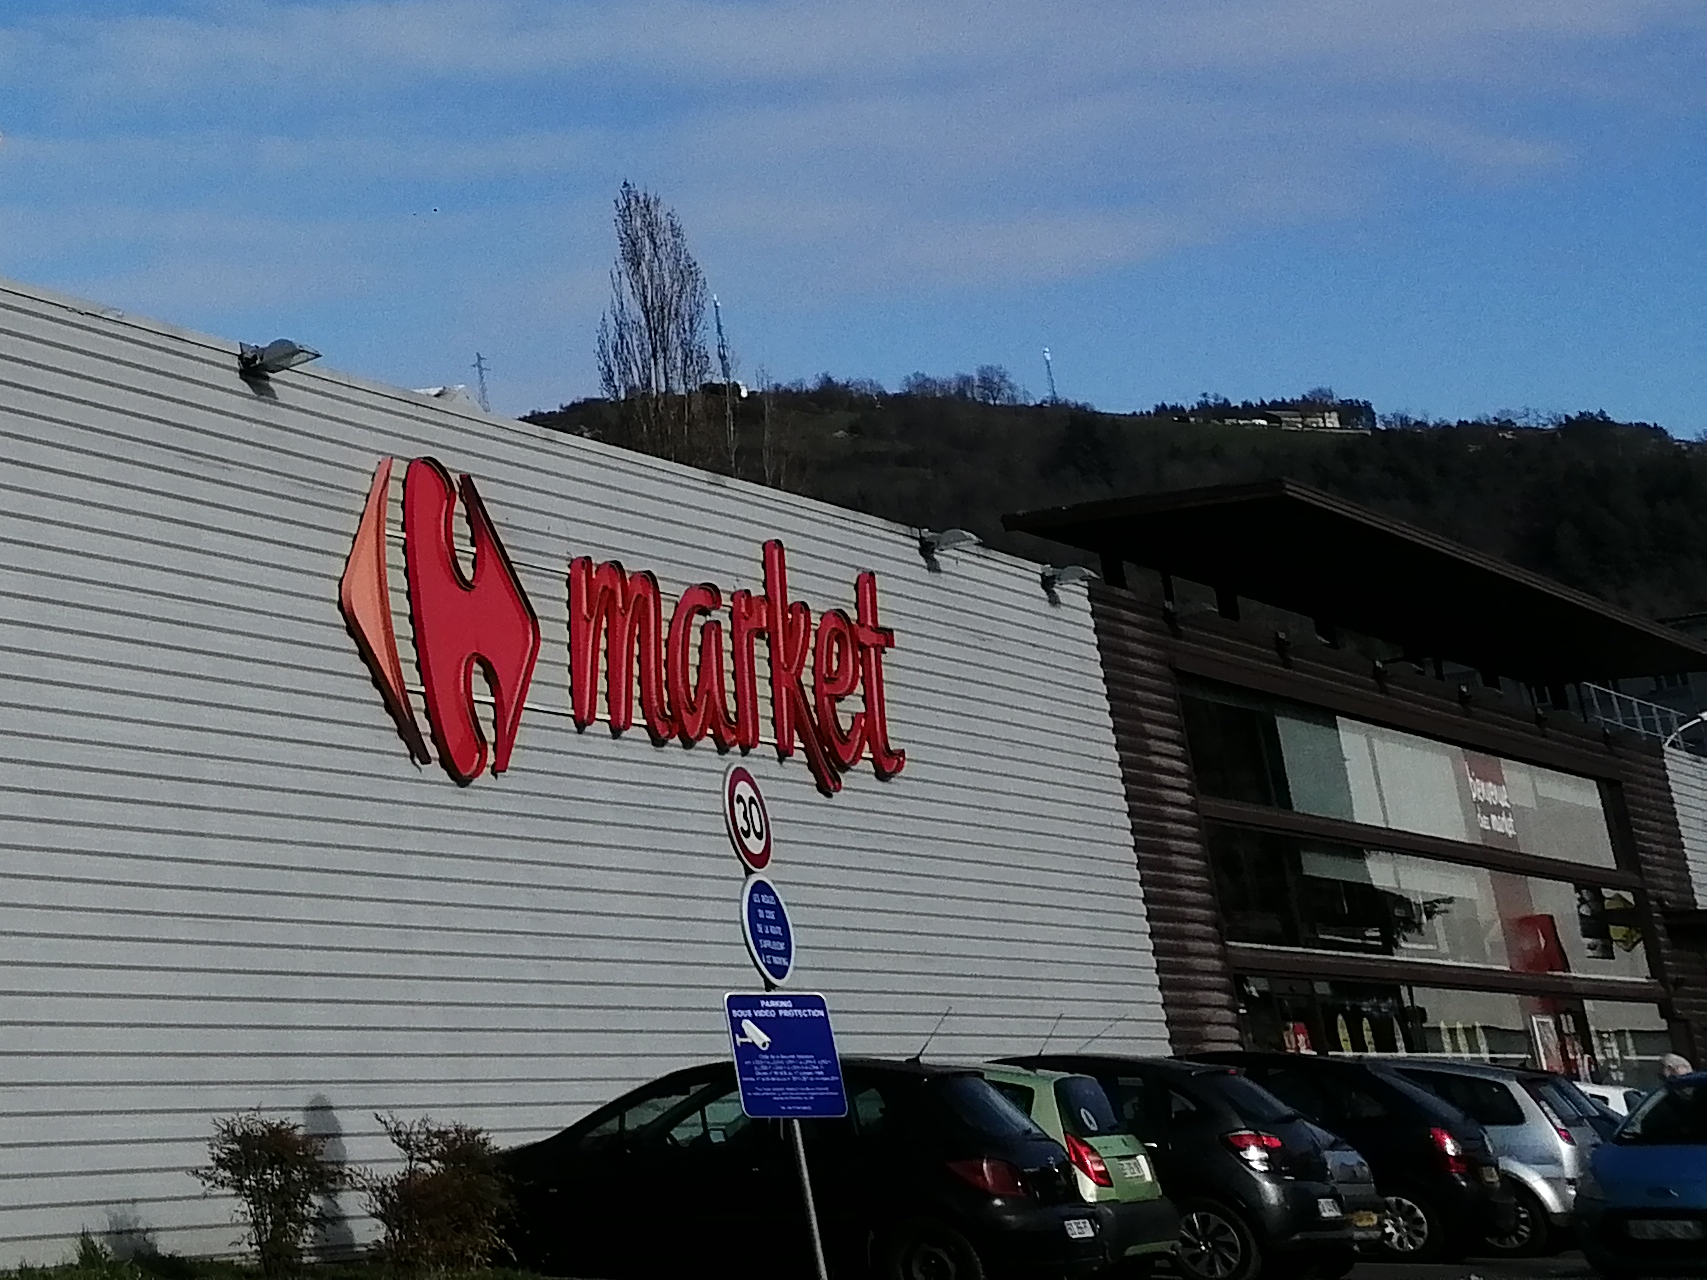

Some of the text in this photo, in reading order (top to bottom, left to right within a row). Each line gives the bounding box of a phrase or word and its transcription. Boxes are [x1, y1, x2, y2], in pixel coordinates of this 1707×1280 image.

[567, 538, 906, 797] market
[736, 794, 764, 841] 30
[760, 999, 793, 1008] PARKING
[778, 1009, 825, 1018] PROTECTION
